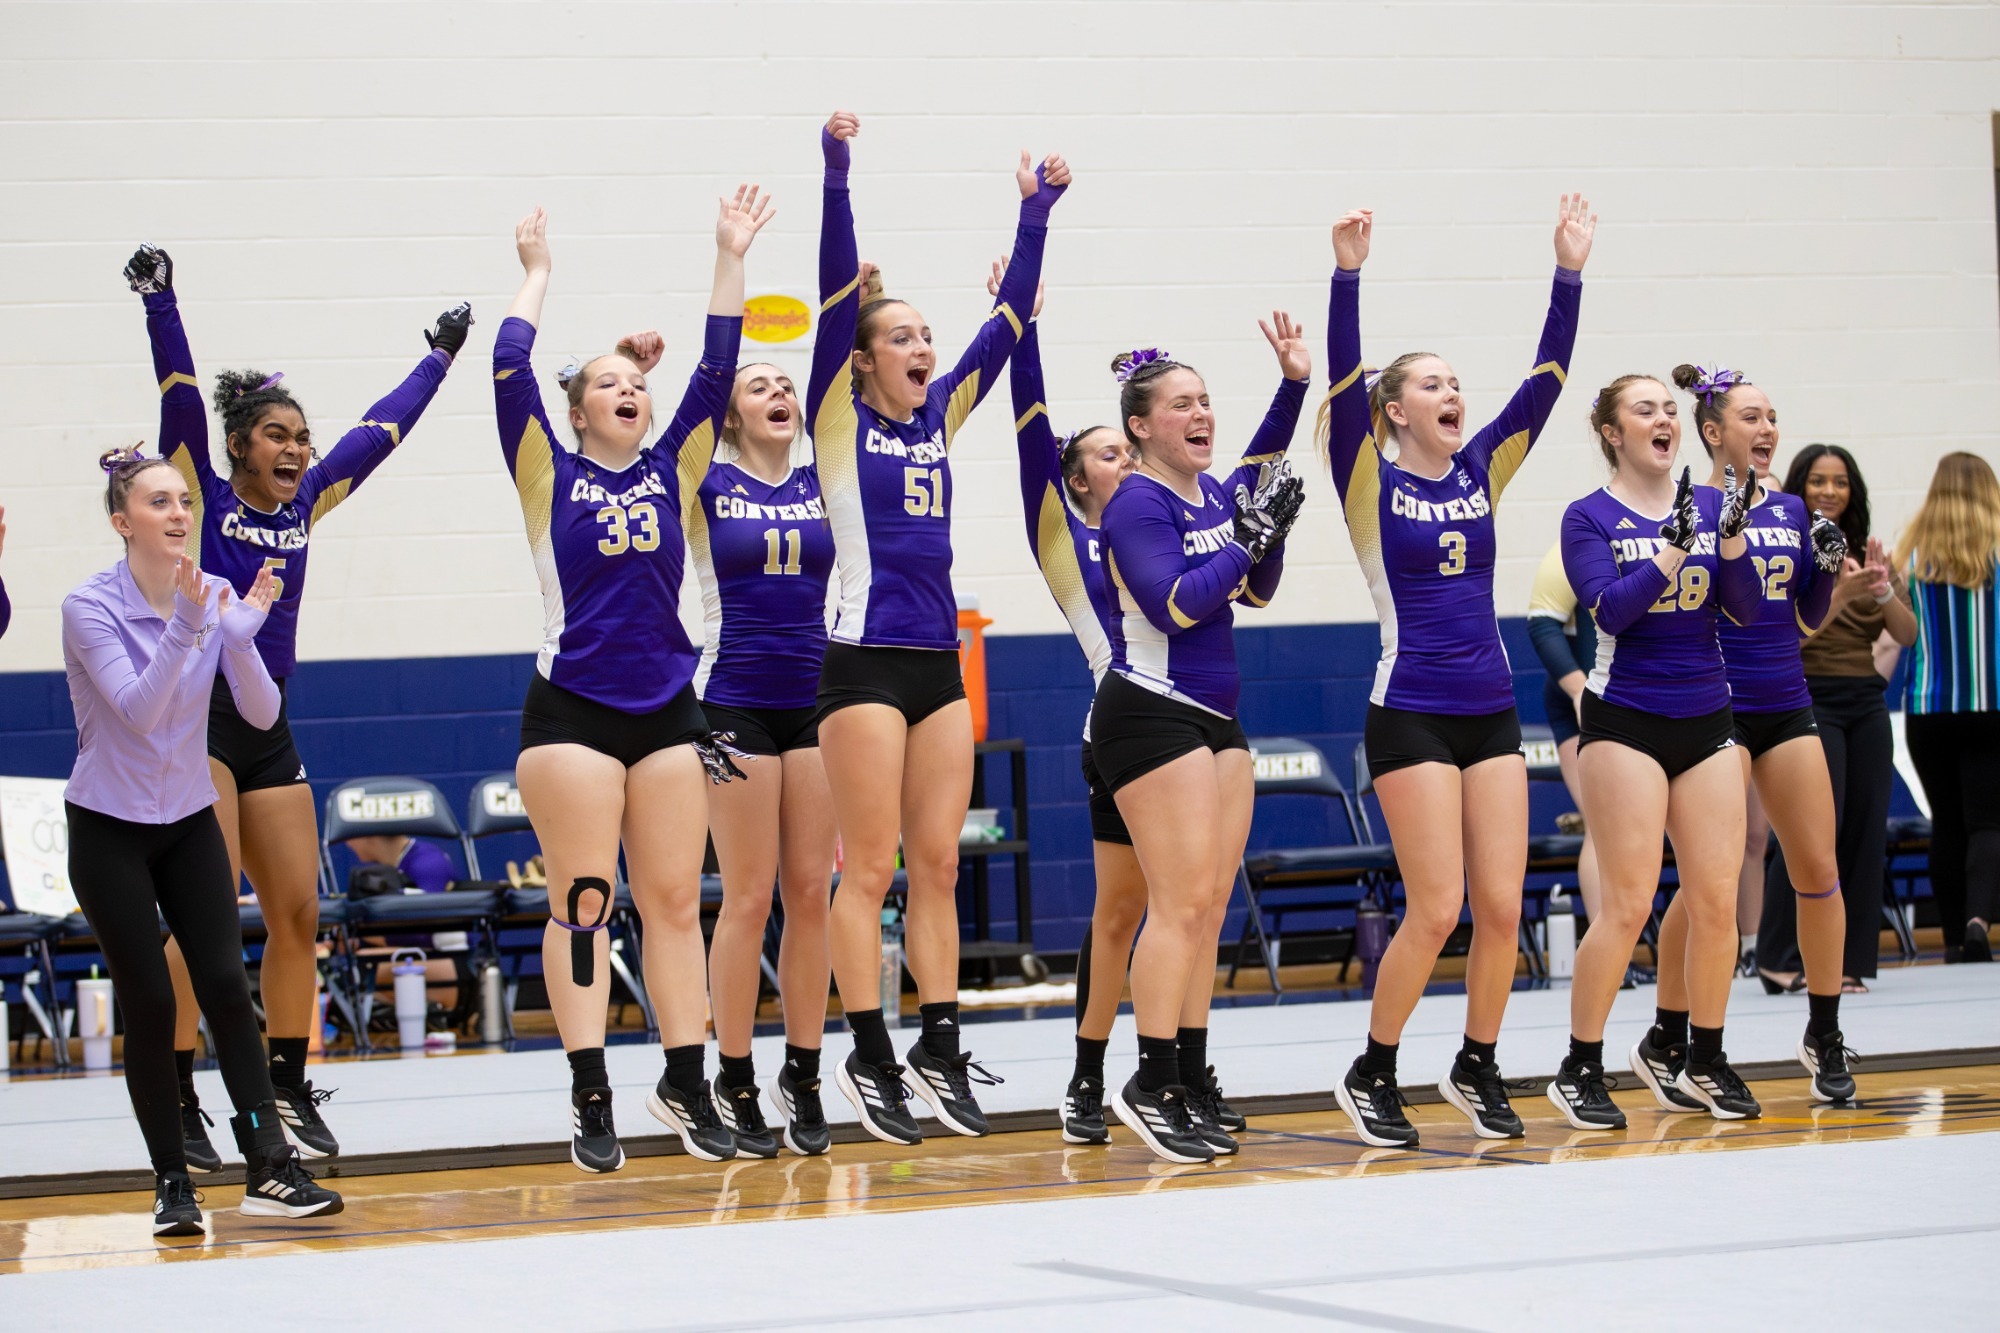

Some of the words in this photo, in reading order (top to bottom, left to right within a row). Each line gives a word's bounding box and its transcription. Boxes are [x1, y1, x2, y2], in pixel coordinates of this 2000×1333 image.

[904, 466, 944, 518] 51
[596, 502, 661, 557] 33
[763, 528, 802, 575] 11
[1438, 531, 1466, 576] 3
[1648, 565, 1710, 613] 28
[1252, 749, 1320, 778] OKER
[338, 789, 433, 821] COKER
